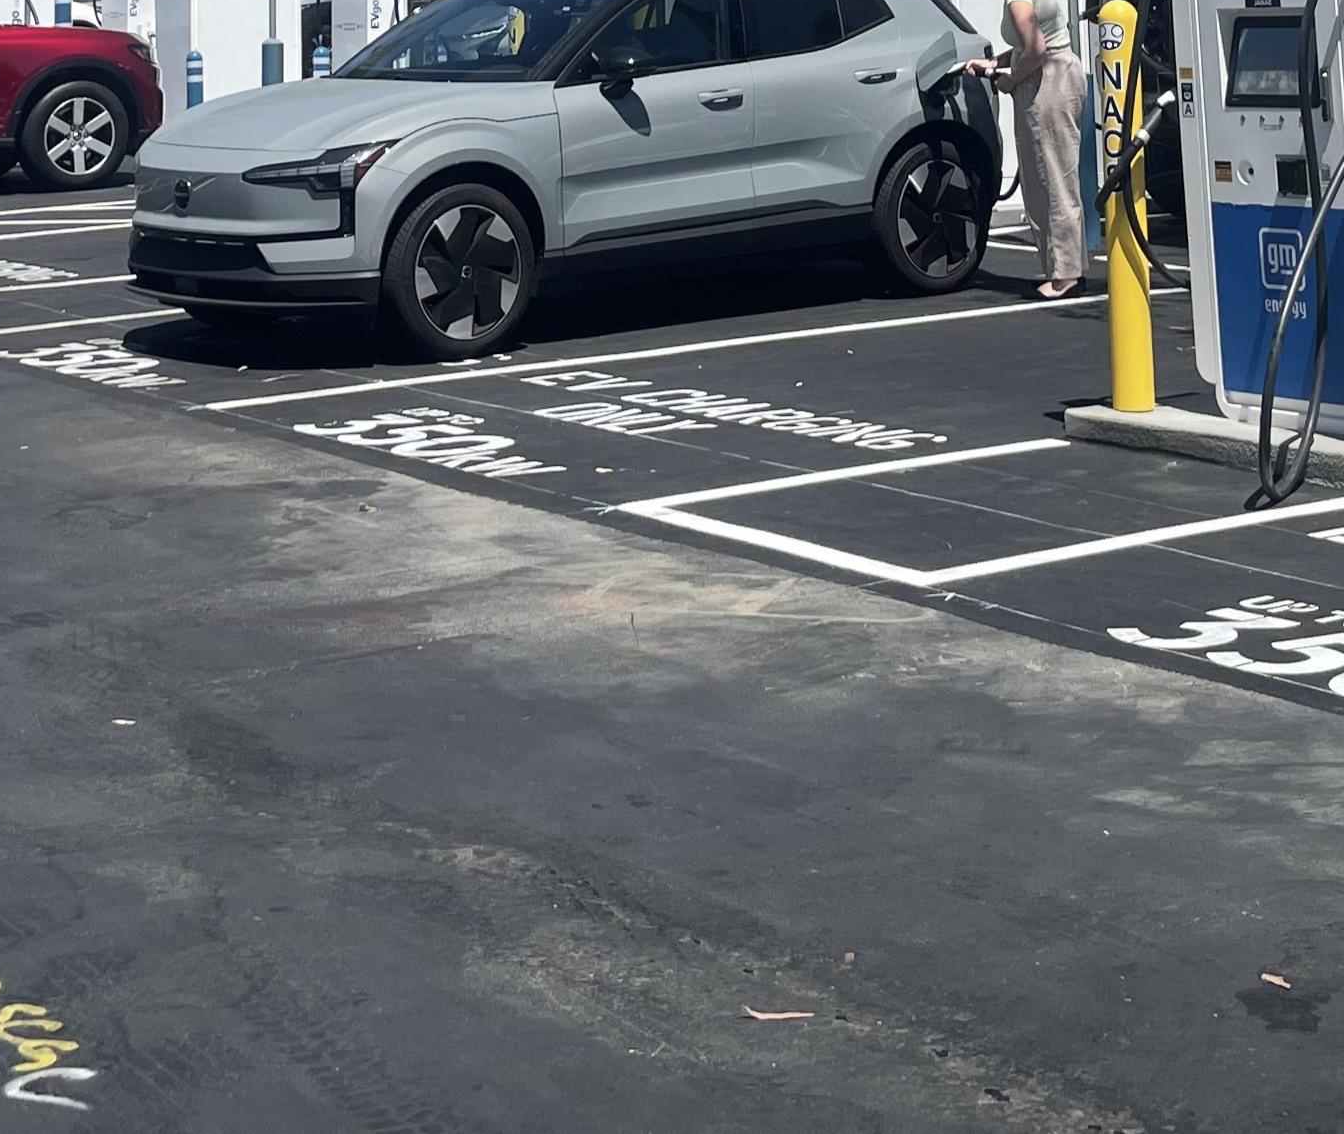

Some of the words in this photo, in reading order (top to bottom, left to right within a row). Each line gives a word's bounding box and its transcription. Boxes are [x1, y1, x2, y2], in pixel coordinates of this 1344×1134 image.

[371, 0, 382, 29] EVgo
[1185, 103, 1193, 115] A
[1267, 243, 1298, 273] gm
[1265, 298, 1307, 320] engy
[520, 370, 654, 392] EV
[620, 388, 948, 451] CHARGING
[533, 402, 719, 436] ONLY
[293, 413, 567, 478] 350kW
[1238, 595, 1320, 613] UP
